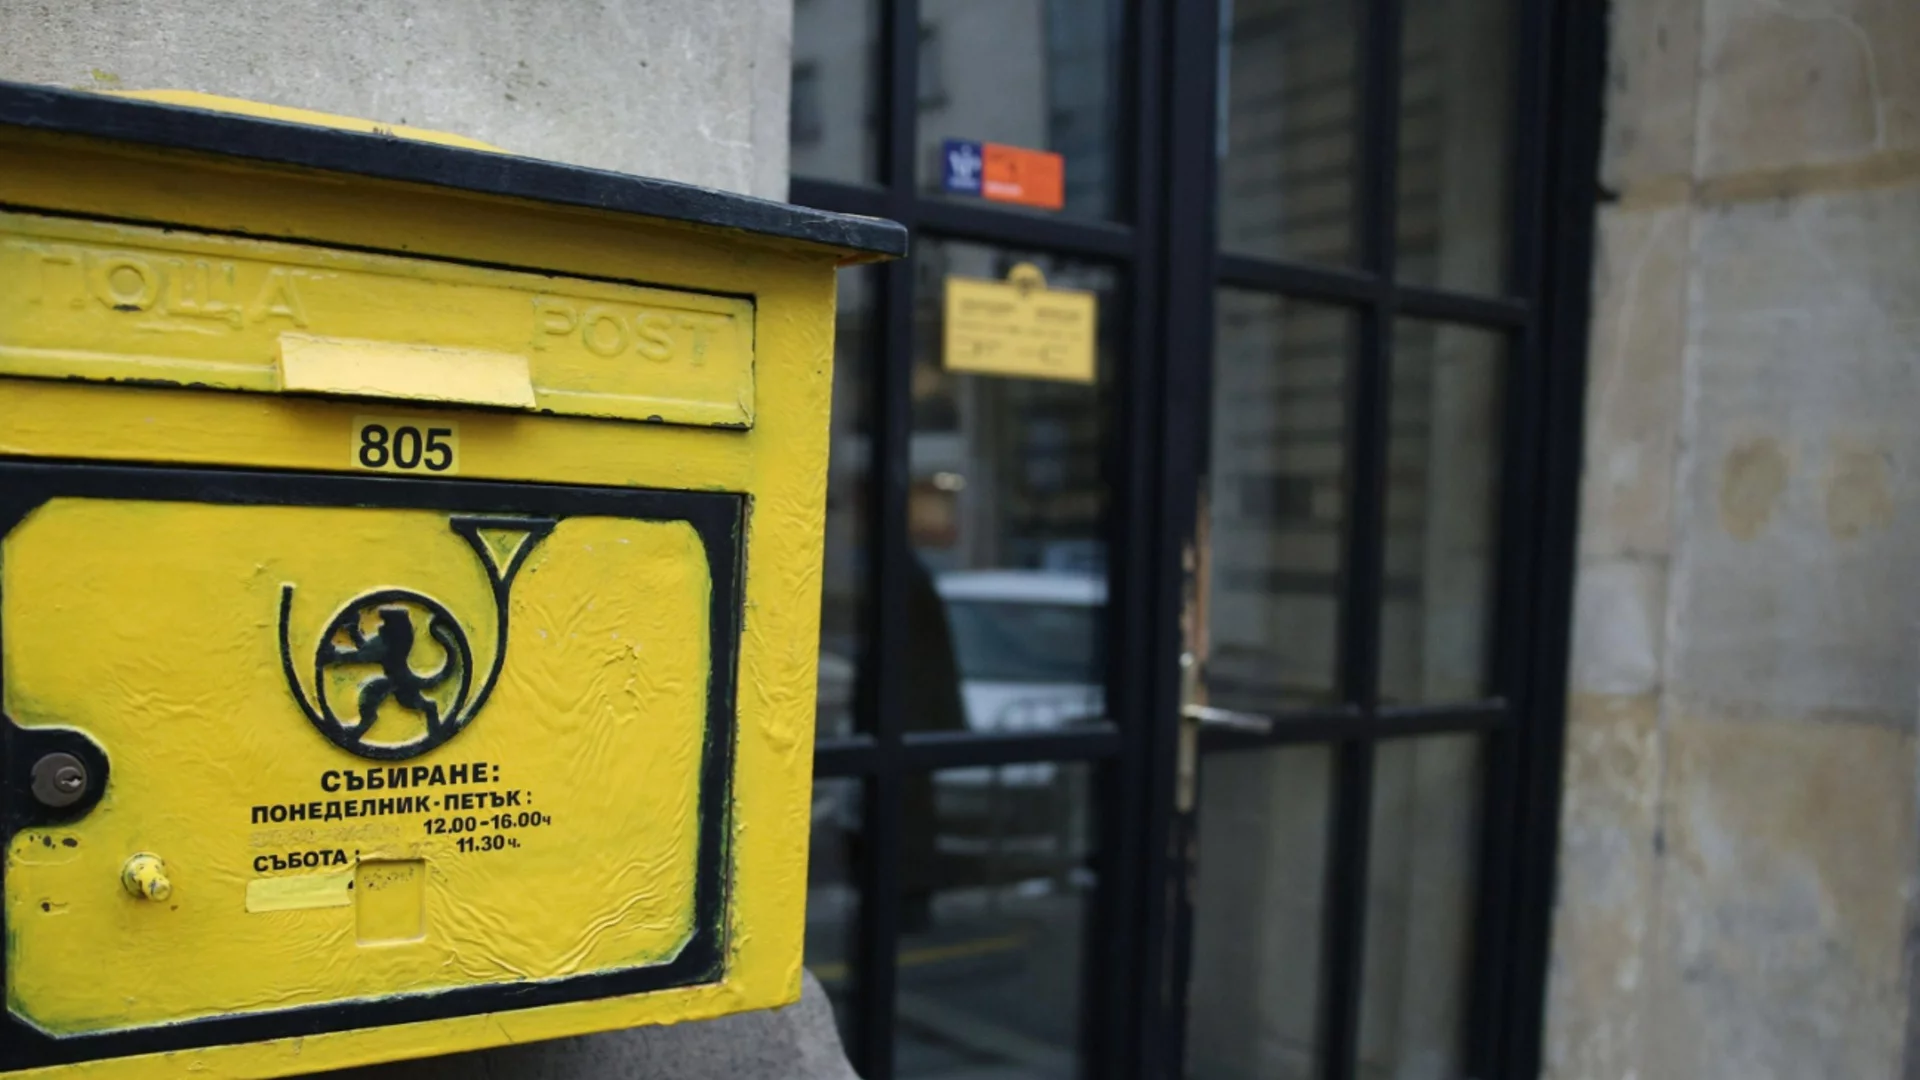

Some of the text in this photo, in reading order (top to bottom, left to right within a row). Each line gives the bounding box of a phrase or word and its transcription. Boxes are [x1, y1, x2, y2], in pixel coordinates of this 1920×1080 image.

[22, 244, 308, 330] ПОЩА
[532, 296, 720, 368] POST
[359, 423, 453, 472] 805
[320, 763, 500, 793] СЪБИРАНЕ:
